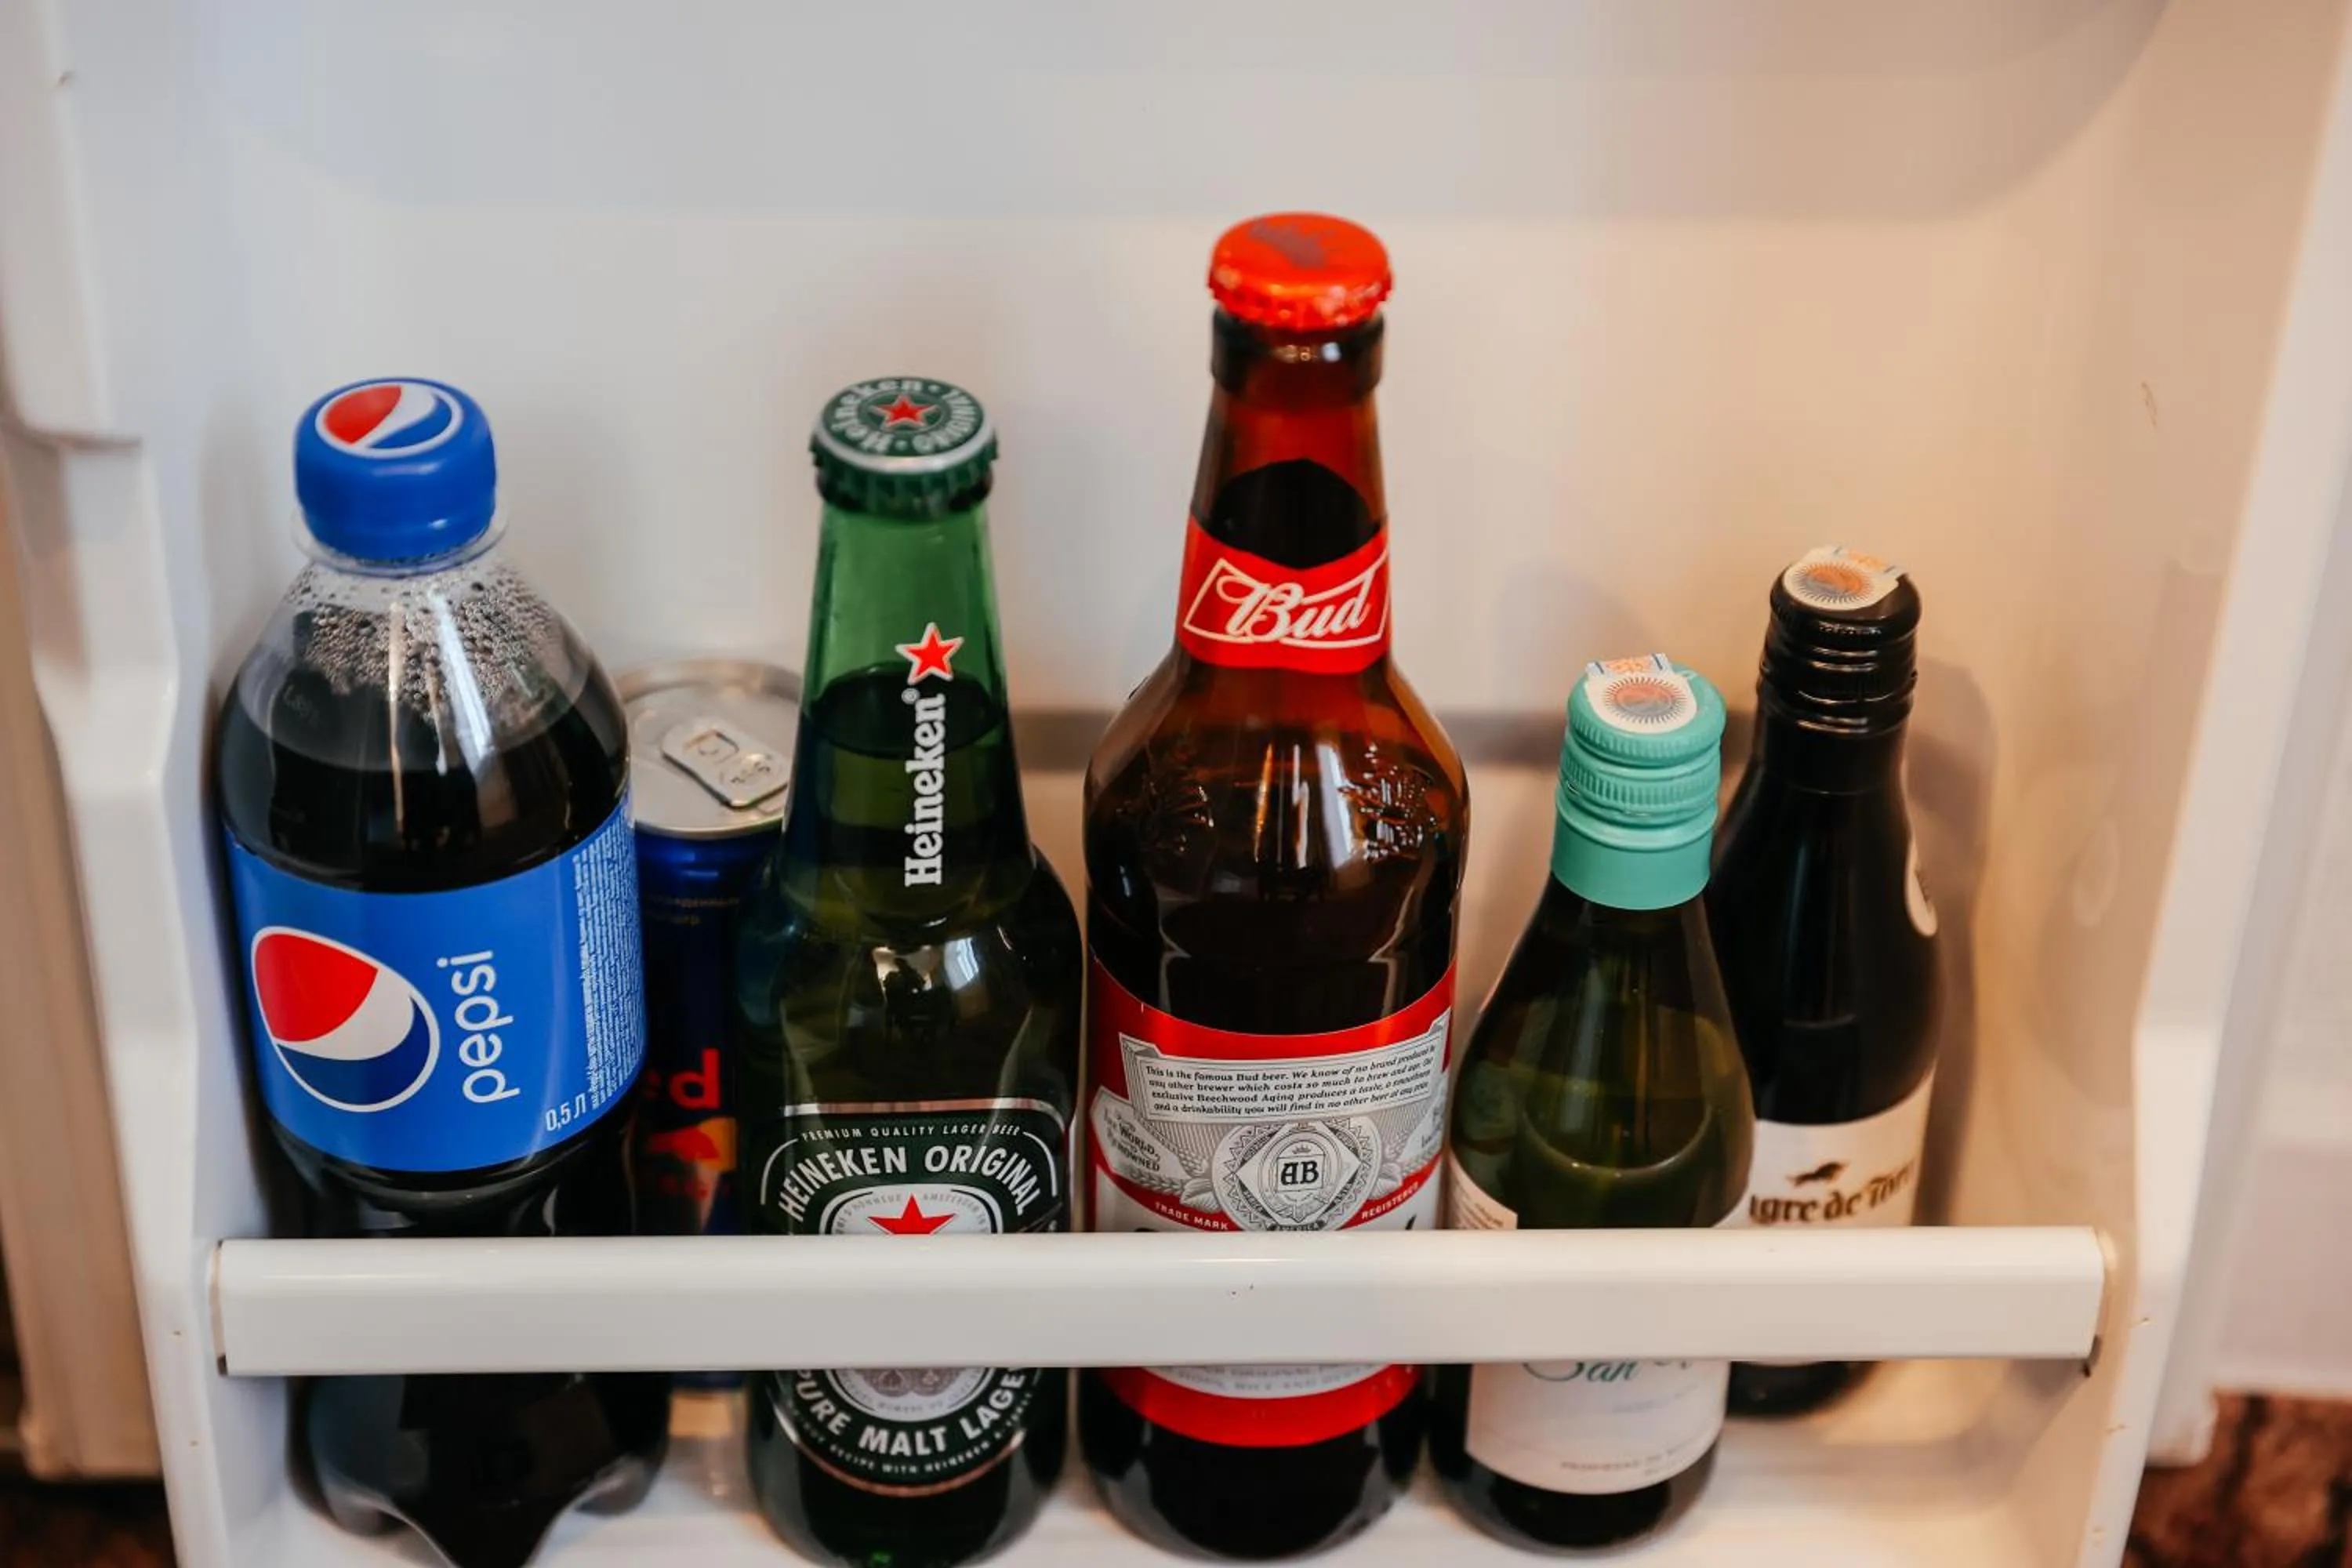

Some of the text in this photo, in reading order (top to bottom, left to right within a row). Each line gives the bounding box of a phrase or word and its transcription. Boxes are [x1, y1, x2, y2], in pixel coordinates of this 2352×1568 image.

[1216, 575, 1372, 643] Bud
[904, 693, 946, 887] Heineken
[437, 949, 521, 1104] pepsi
[1146, 1065, 1163, 1076] This
[1166, 1069, 1174, 1078] is
[1177, 1070, 1192, 1080] the
[1194, 1072, 1233, 1081] famous
[1261, 1073, 1289, 1081] beer.
[1311, 1069, 1339, 1078] know
[1341, 1065, 1356, 1075] of
[1370, 1057, 1396, 1071] brand
[1168, 1082, 1194, 1091] other
[1197, 1083, 1235, 1092] brewer
[1238, 1083, 1271, 1092] which
[1274, 1080, 1302, 1091] costs
[1322, 1077, 1351, 1087] much
[1367, 1070, 1391, 1082] brew
[1152, 1091, 1194, 1102] exclusive
[1197, 1094, 1258, 1103] Beechwood
[1261, 1092, 1294, 1102] Aging
[1298, 1087, 1347, 1101] produces
[1154, 1102, 1171, 1111] and
[1181, 1104, 1242, 1115] drinkability
[1244, 1106, 1265, 1115] you
[1268, 1103, 1287, 1112] will
[1289, 1102, 1312, 1112] find
[1315, 1099, 1325, 1109] in
[1343, 1096, 1369, 1107] other
[546, 1101, 572, 1131] 0,5
[801, 1128, 862, 1142] PREMIUM
[870, 1126, 935, 1137] QUALITY
[942, 1123, 986, 1134] LAGER
[778, 1144, 1041, 1222] HEINEKEN ORIGINAL
[1280, 1160, 1319, 1185] AB
[1155, 1201, 1229, 1230] TRADE MARK
[858, 1424, 947, 1457] MALT
[959, 1369, 1026, 1439] LAGE
